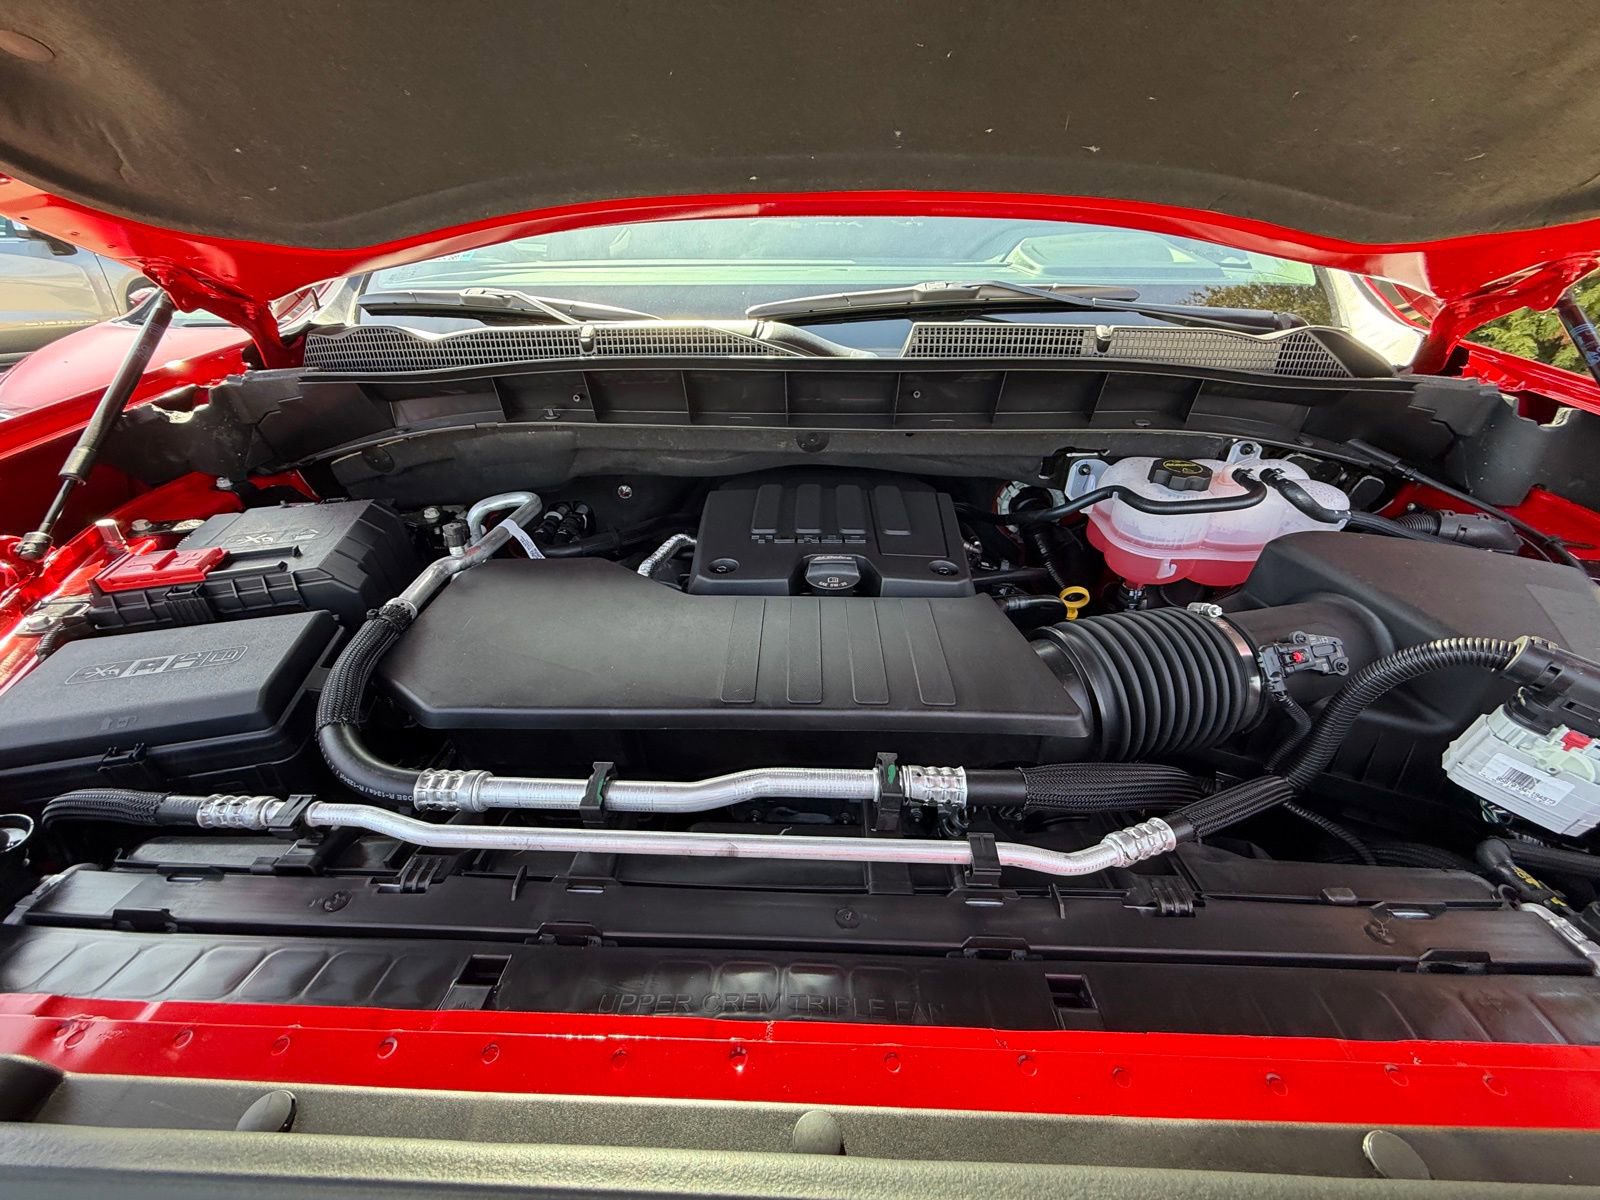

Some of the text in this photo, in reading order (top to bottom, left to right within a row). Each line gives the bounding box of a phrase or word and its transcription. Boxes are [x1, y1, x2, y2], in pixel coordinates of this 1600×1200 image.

[396, 794, 414, 802] OSE
[598, 992, 692, 1013] UPPER
[789, 993, 887, 1019] TRIPLE
